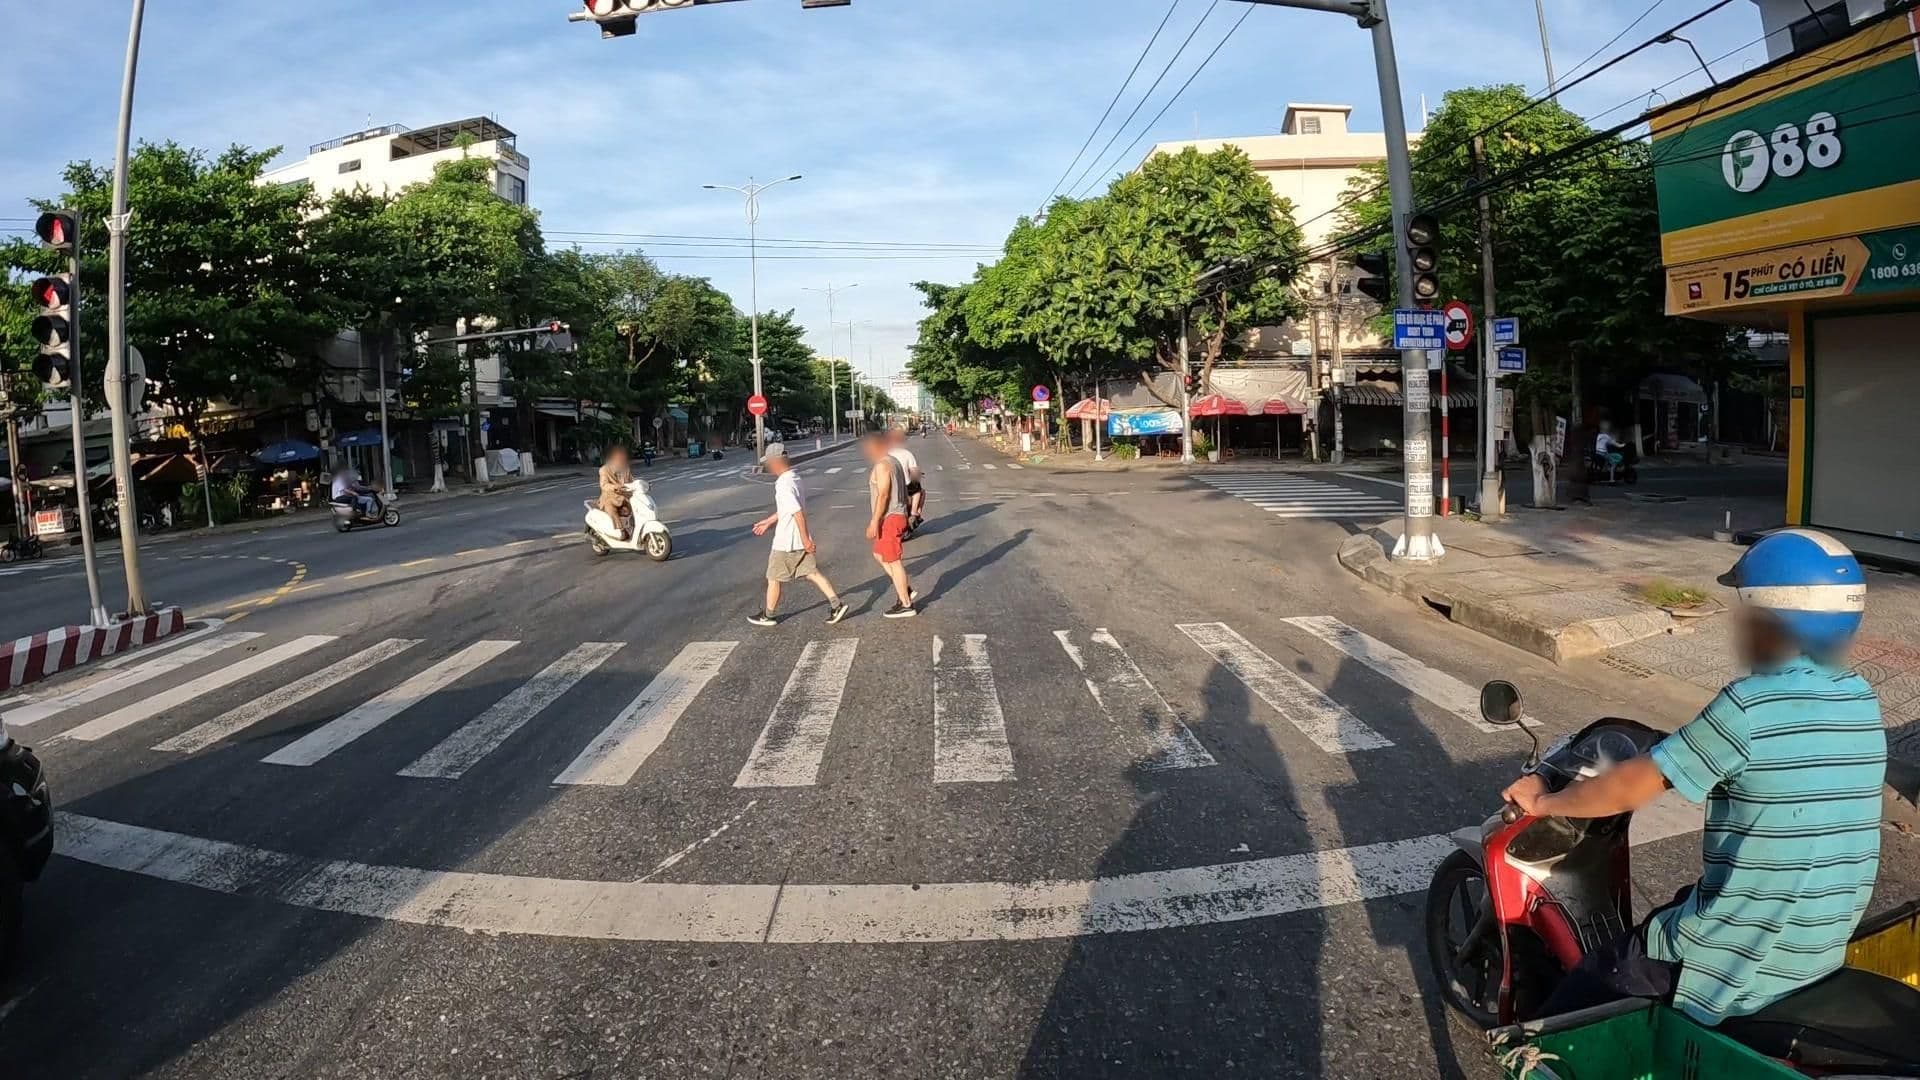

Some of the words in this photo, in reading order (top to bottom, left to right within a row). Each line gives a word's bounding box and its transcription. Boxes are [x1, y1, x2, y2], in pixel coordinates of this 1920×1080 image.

[1723, 269, 1750, 300] 15
[1750, 264, 1774, 278] PHÚT
[1779, 256, 1805, 279] CÓ
[1811, 247, 1846, 276] LIỀN
[1871, 266, 1899, 280] 1800
